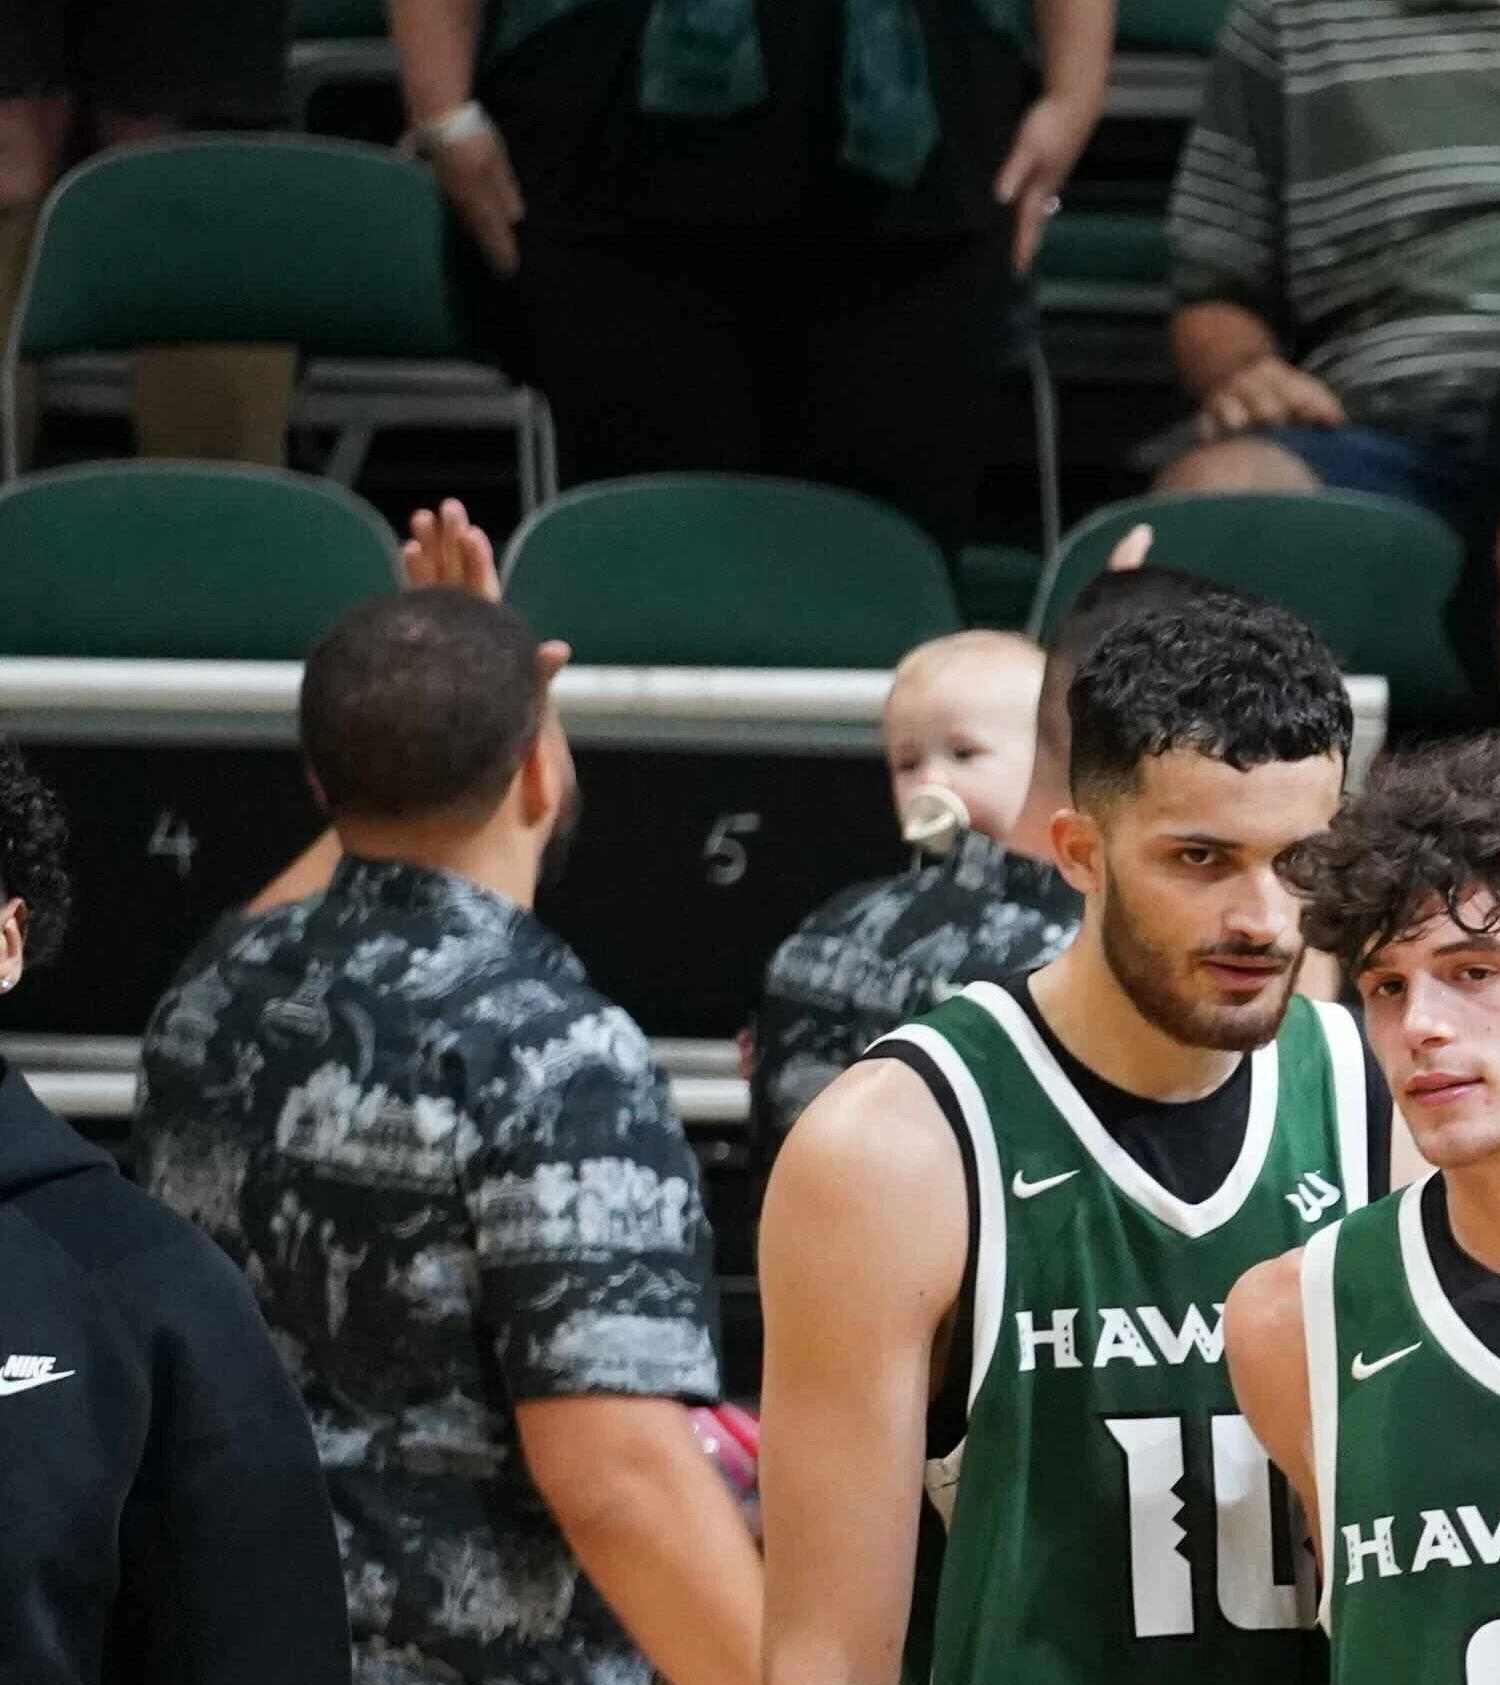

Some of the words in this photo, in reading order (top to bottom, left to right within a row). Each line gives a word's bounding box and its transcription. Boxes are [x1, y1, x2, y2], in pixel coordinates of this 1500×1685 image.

[147, 808, 198, 877] 4
[700, 813, 761, 886] 5
[3, 1354, 57, 1378] NIKE
[1104, 1414, 1318, 1638] 10
